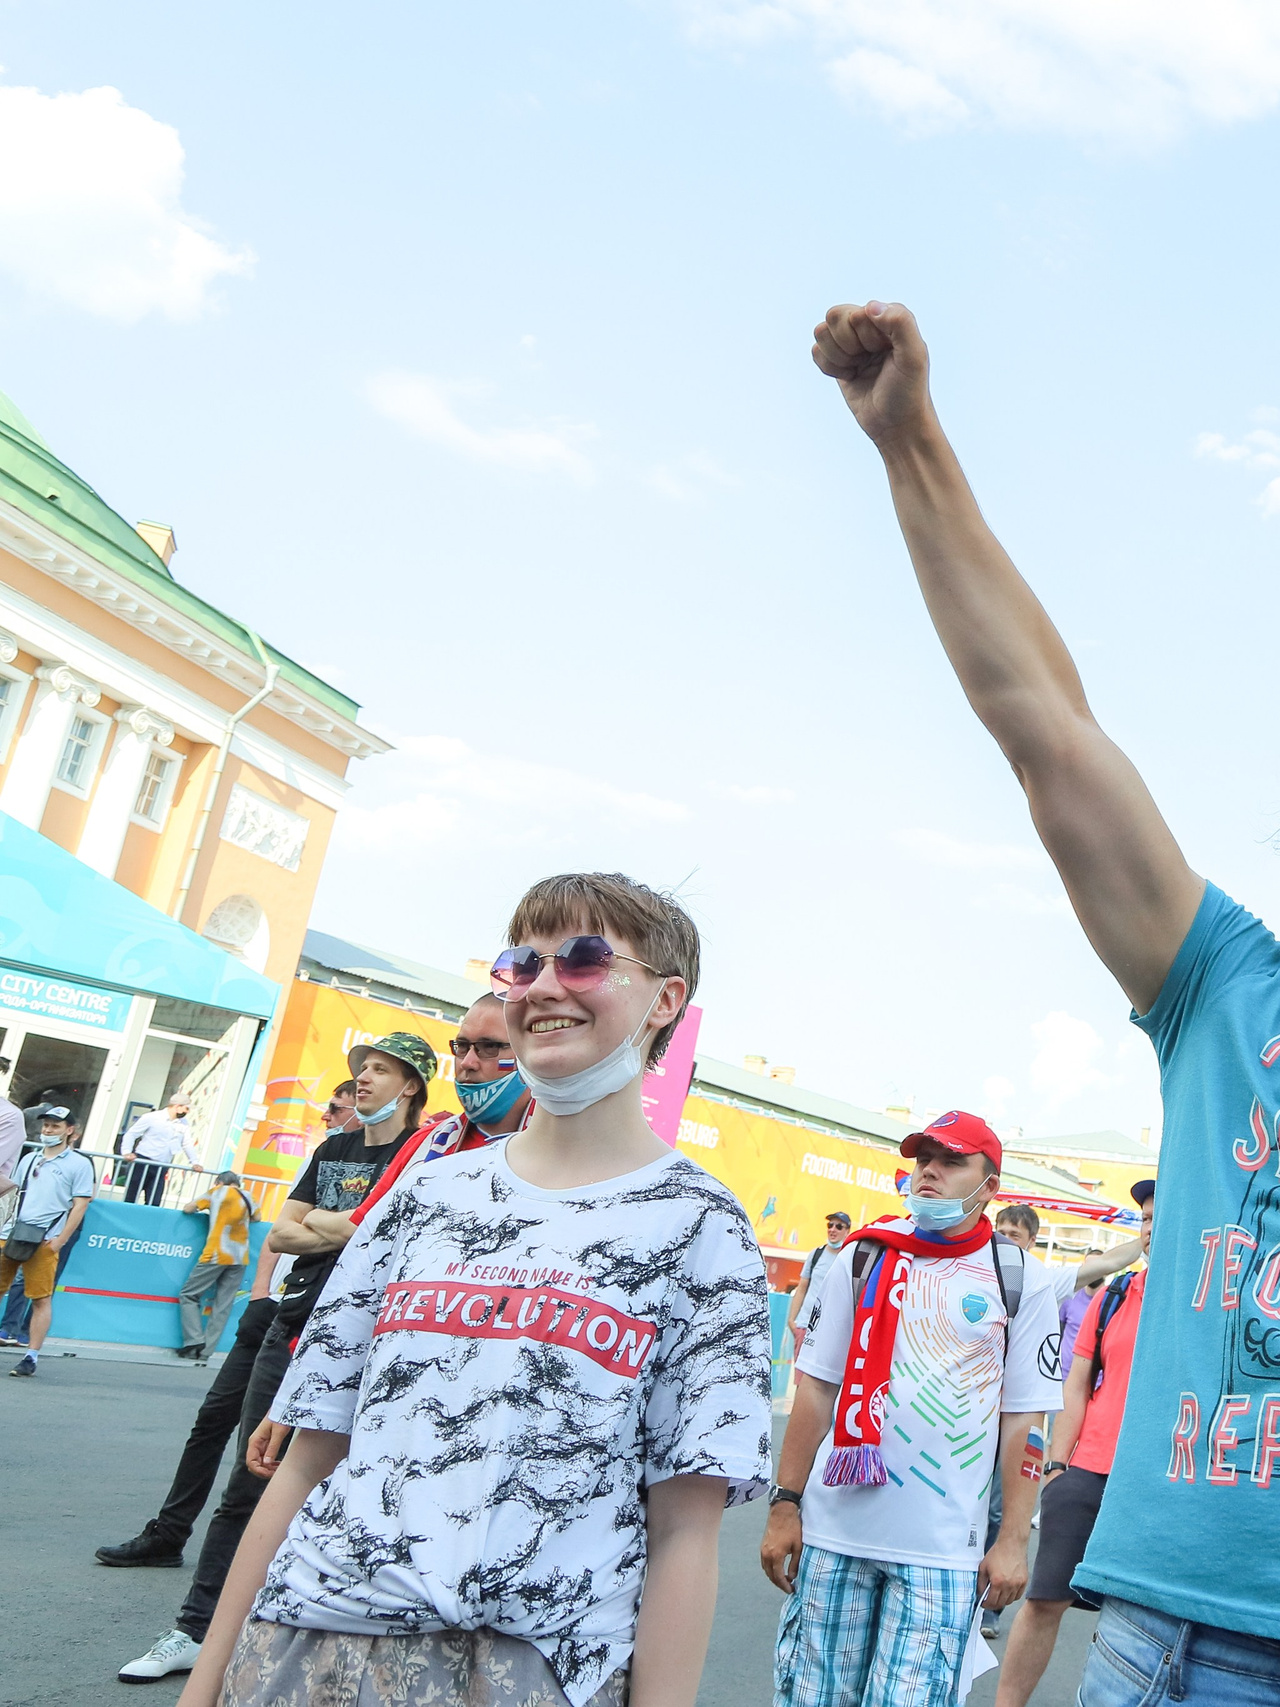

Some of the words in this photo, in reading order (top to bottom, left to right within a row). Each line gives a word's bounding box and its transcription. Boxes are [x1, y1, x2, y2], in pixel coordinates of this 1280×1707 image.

[0, 974, 45, 997] CITY
[45, 984, 113, 1013] CENTRE
[801, 1153, 855, 1184] FOOTBALL
[87, 1234, 107, 1249] ST
[107, 1236, 193, 1259] PETERSBURG
[444, 1262, 469, 1277] MY
[471, 1264, 528, 1283] SECOND
[529, 1267, 574, 1286] NAME
[575, 1274, 596, 1290] IS
